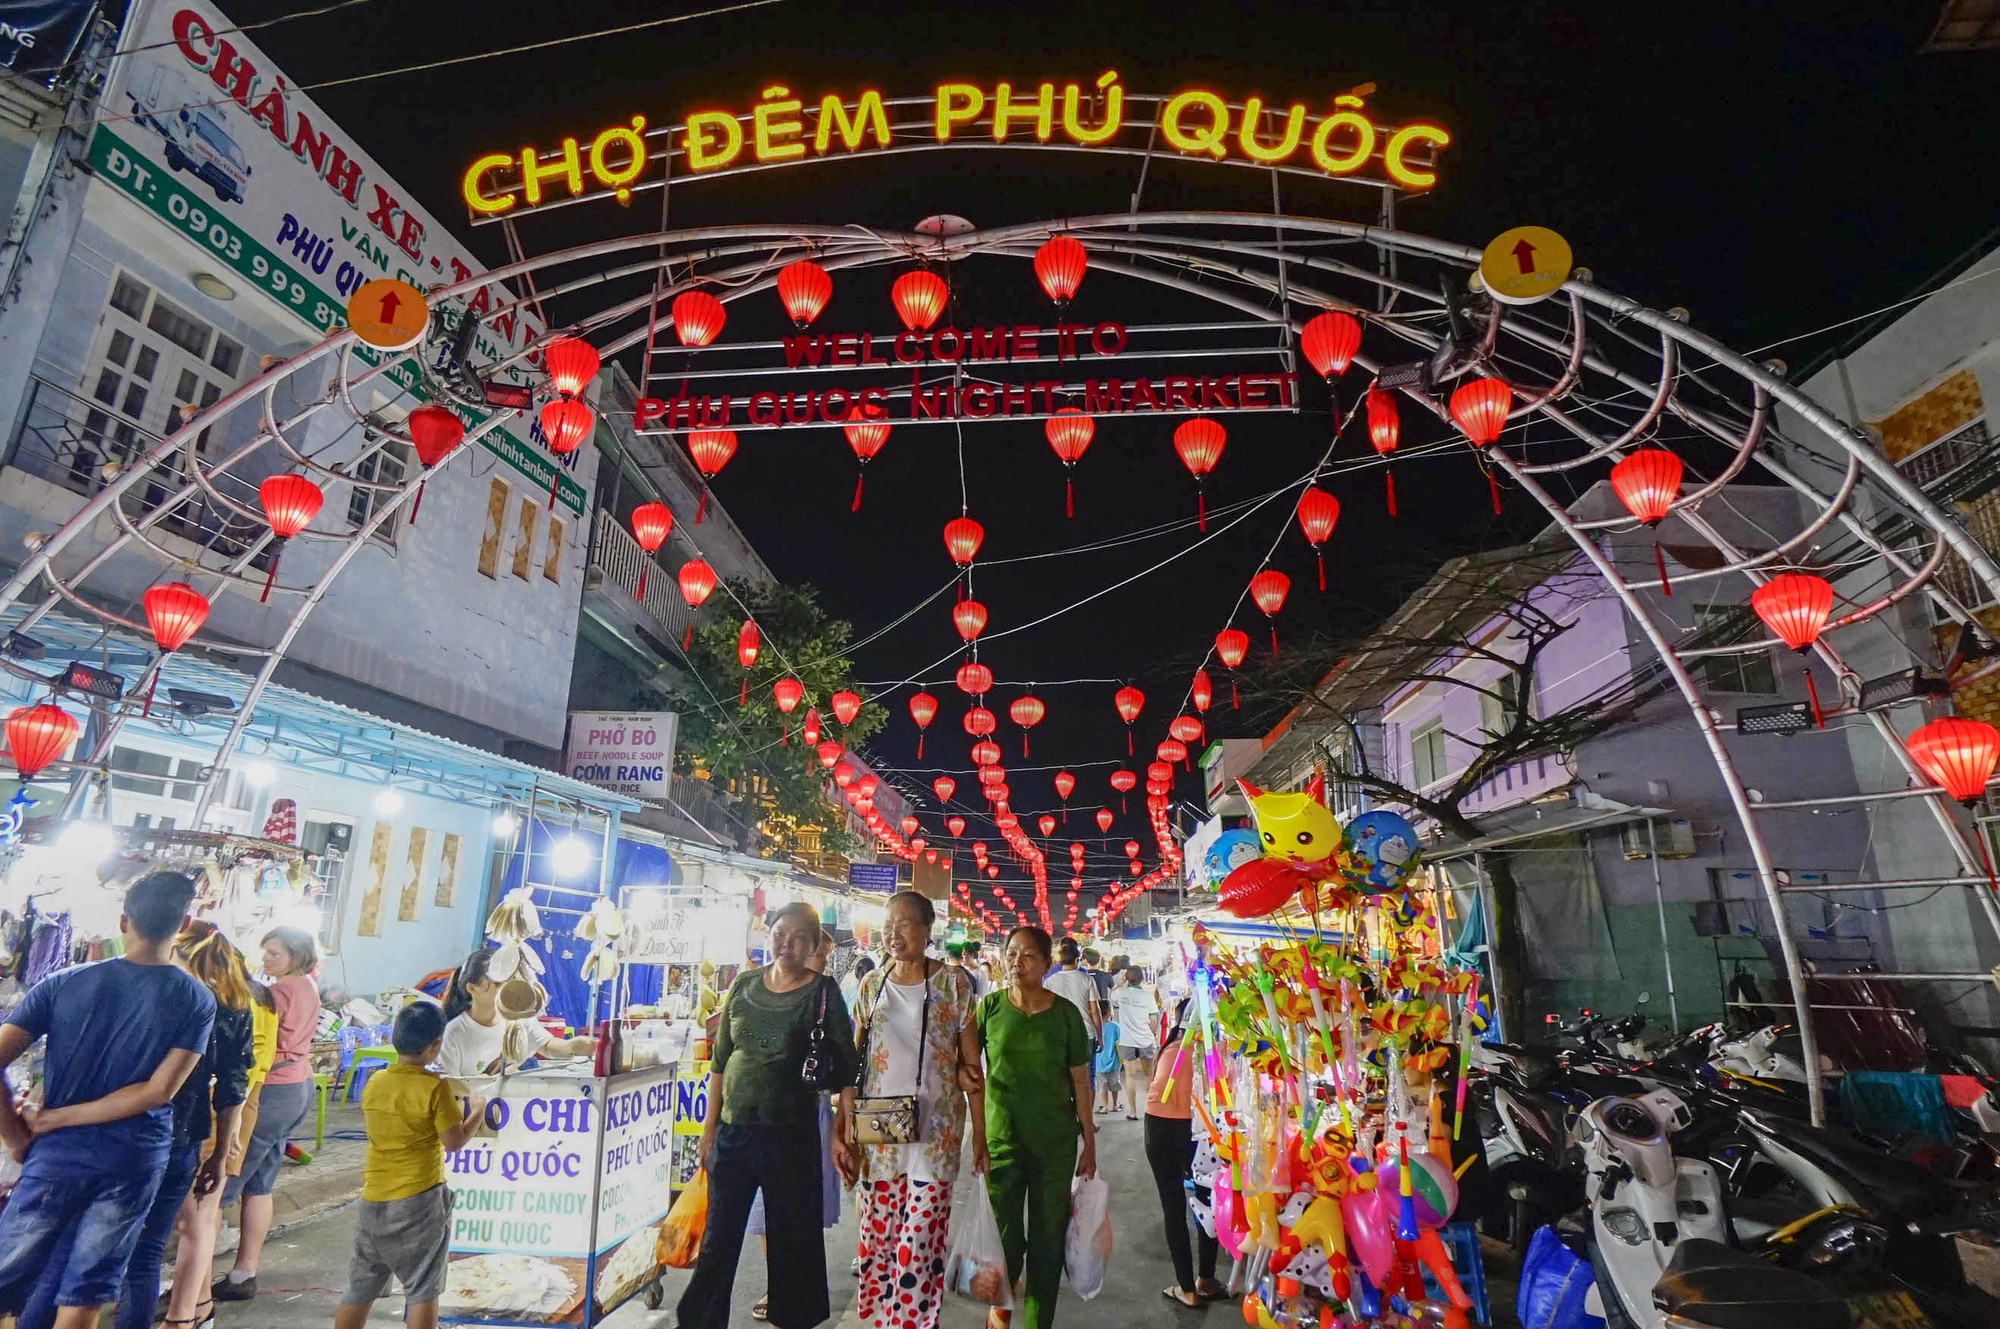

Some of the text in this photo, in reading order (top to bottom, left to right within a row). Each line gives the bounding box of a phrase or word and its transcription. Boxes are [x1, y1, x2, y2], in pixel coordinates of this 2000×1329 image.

[172, 9, 364, 208] CHÀNH
[367, 183, 426, 264] XE
[463, 70, 1450, 212] CHỢ ĐÊM PHÚ QUỐC
[107, 148, 158, 200] ĐT:
[168, 194, 242, 260] 0903
[252, 256, 306, 305] 999
[276, 213, 334, 275] PHÚ
[341, 216, 389, 272] VẬN
[783, 322, 1128, 369] WELCOME TO
[634, 372, 1297, 432] PHU QUOC NIGHT MARKET
[576, 751, 664, 760] BEEF NOODLE SOUP
[588, 723, 657, 745] PHỞ BÒ
[572, 763, 664, 781] CƠM RANG
[620, 784, 641, 793] RICE
[522, 1084, 594, 1132] CHỈ
[606, 1090, 642, 1137] KẸO
[501, 1140, 581, 1181] QUỐC
[606, 1121, 668, 1175] PHÚ QUỐC
[453, 1187, 588, 1215] CONUT CANDY
[455, 1219, 552, 1246] PHU QUOC
